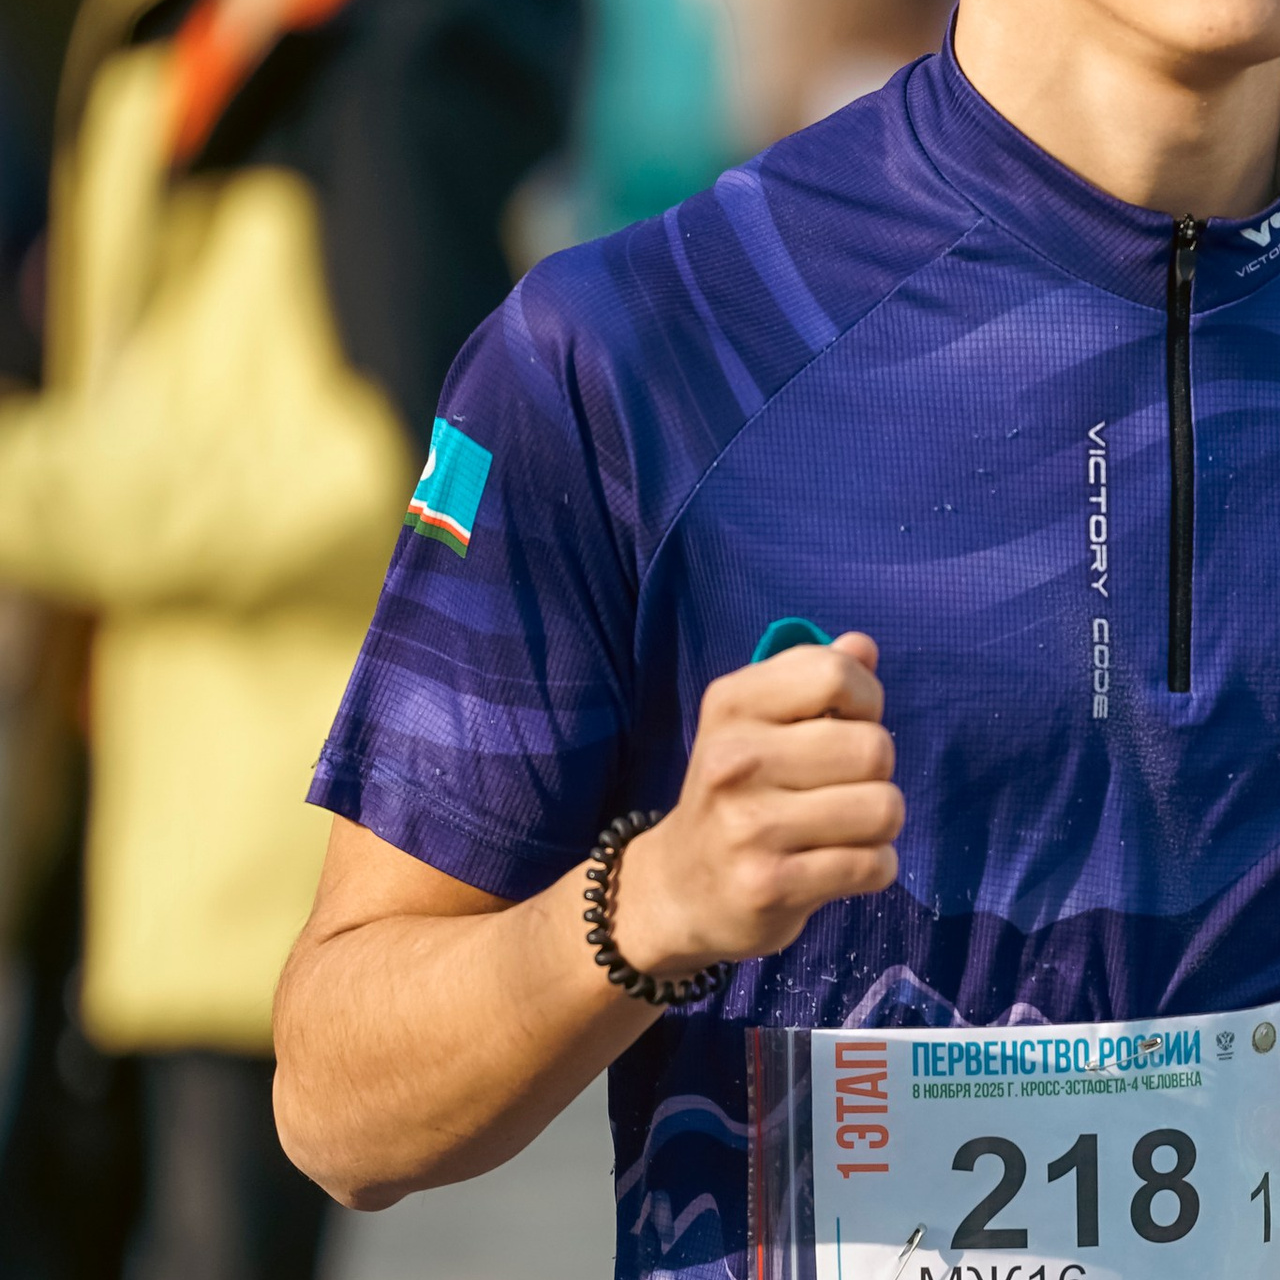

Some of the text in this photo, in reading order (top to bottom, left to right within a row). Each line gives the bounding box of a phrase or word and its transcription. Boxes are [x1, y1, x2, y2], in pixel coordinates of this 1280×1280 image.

[1087, 421, 1109, 719] VICTORY CODE
[912, 1029, 1201, 1077] ПЕРВЕНСТВО РОССИИ
[912, 1070, 1202, 1099] 8 НОЯБРЯ 2025 Г. КРОСС-ЭСТАФЕТА-4 ЧЕЛОВЕКА
[835, 1042, 889, 1179] 1 ЭТАП
[950, 1129, 1200, 1250] 218
[1250, 1172, 1272, 1244] 1
